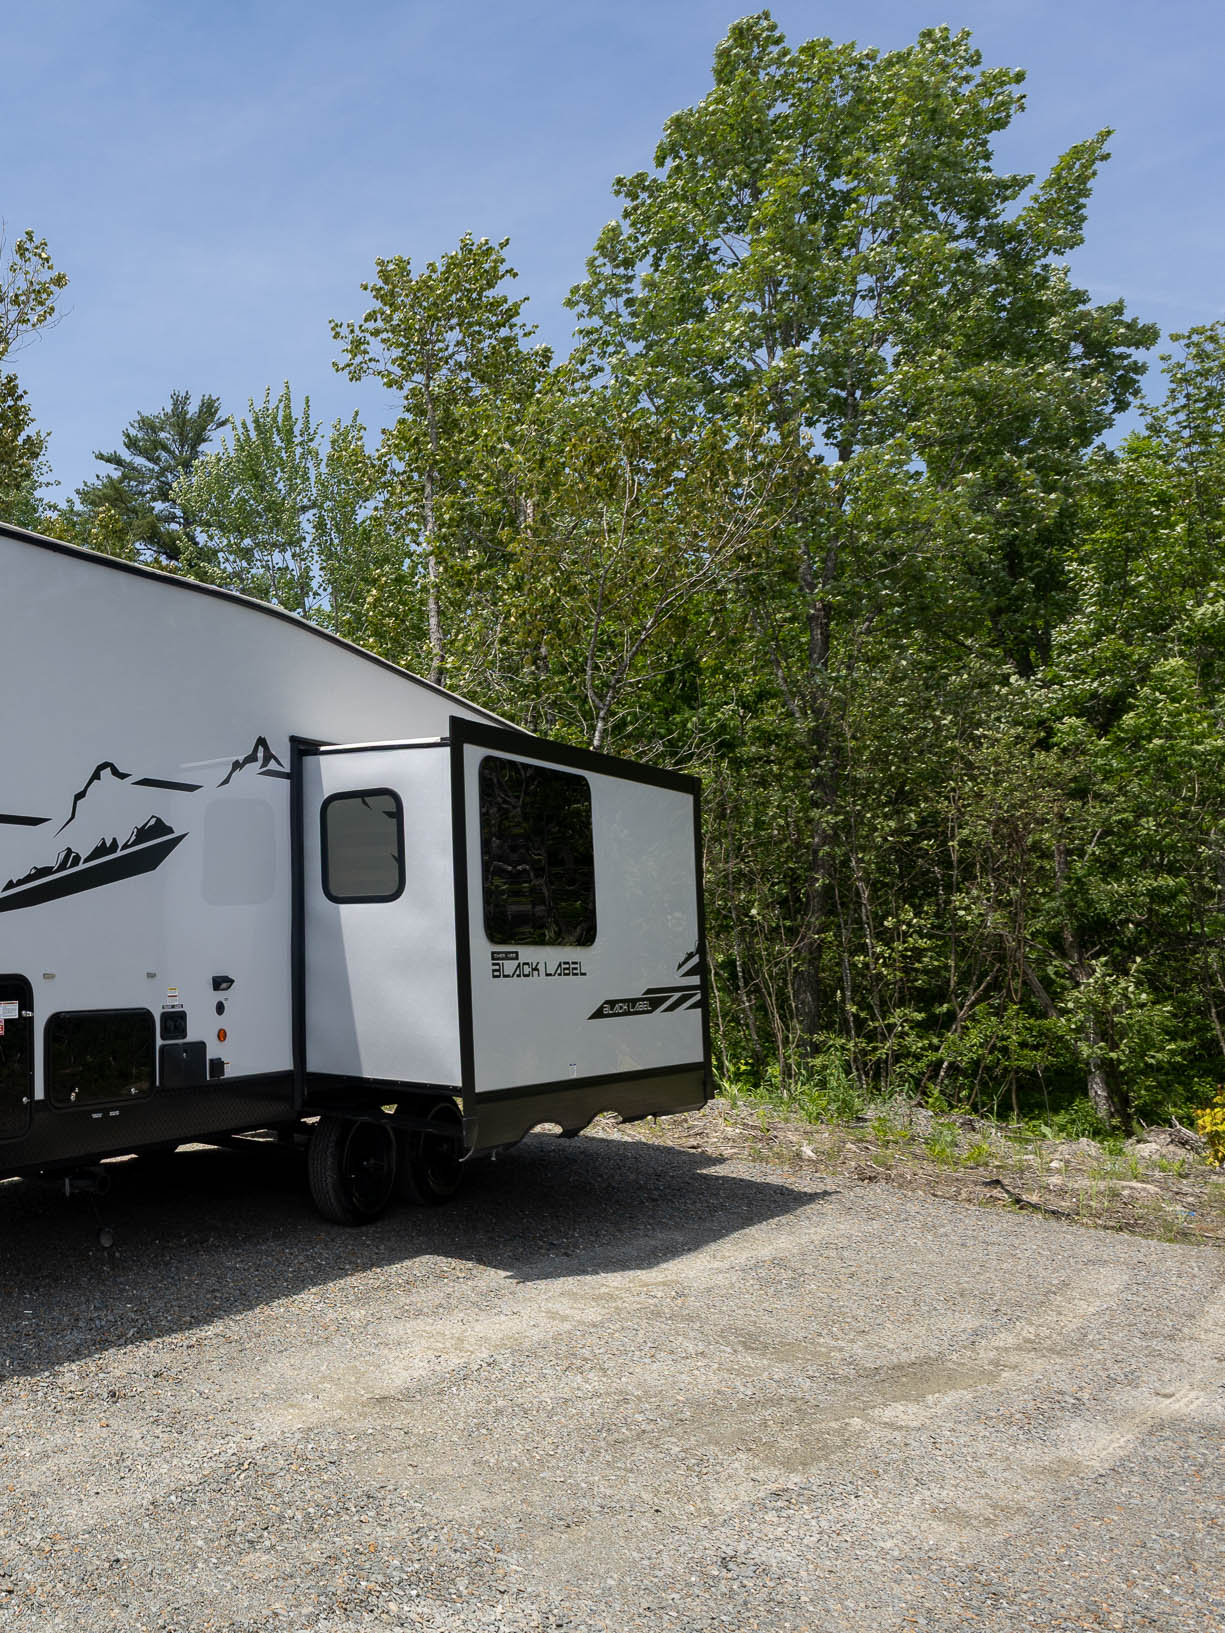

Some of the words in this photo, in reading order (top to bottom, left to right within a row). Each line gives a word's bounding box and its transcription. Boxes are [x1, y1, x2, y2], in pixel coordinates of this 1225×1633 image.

[491, 961, 540, 979] BLACK
[544, 961, 587, 977] LABEL
[603, 1002, 628, 1014] BLACK
[629, 1001, 652, 1012] LABEL
